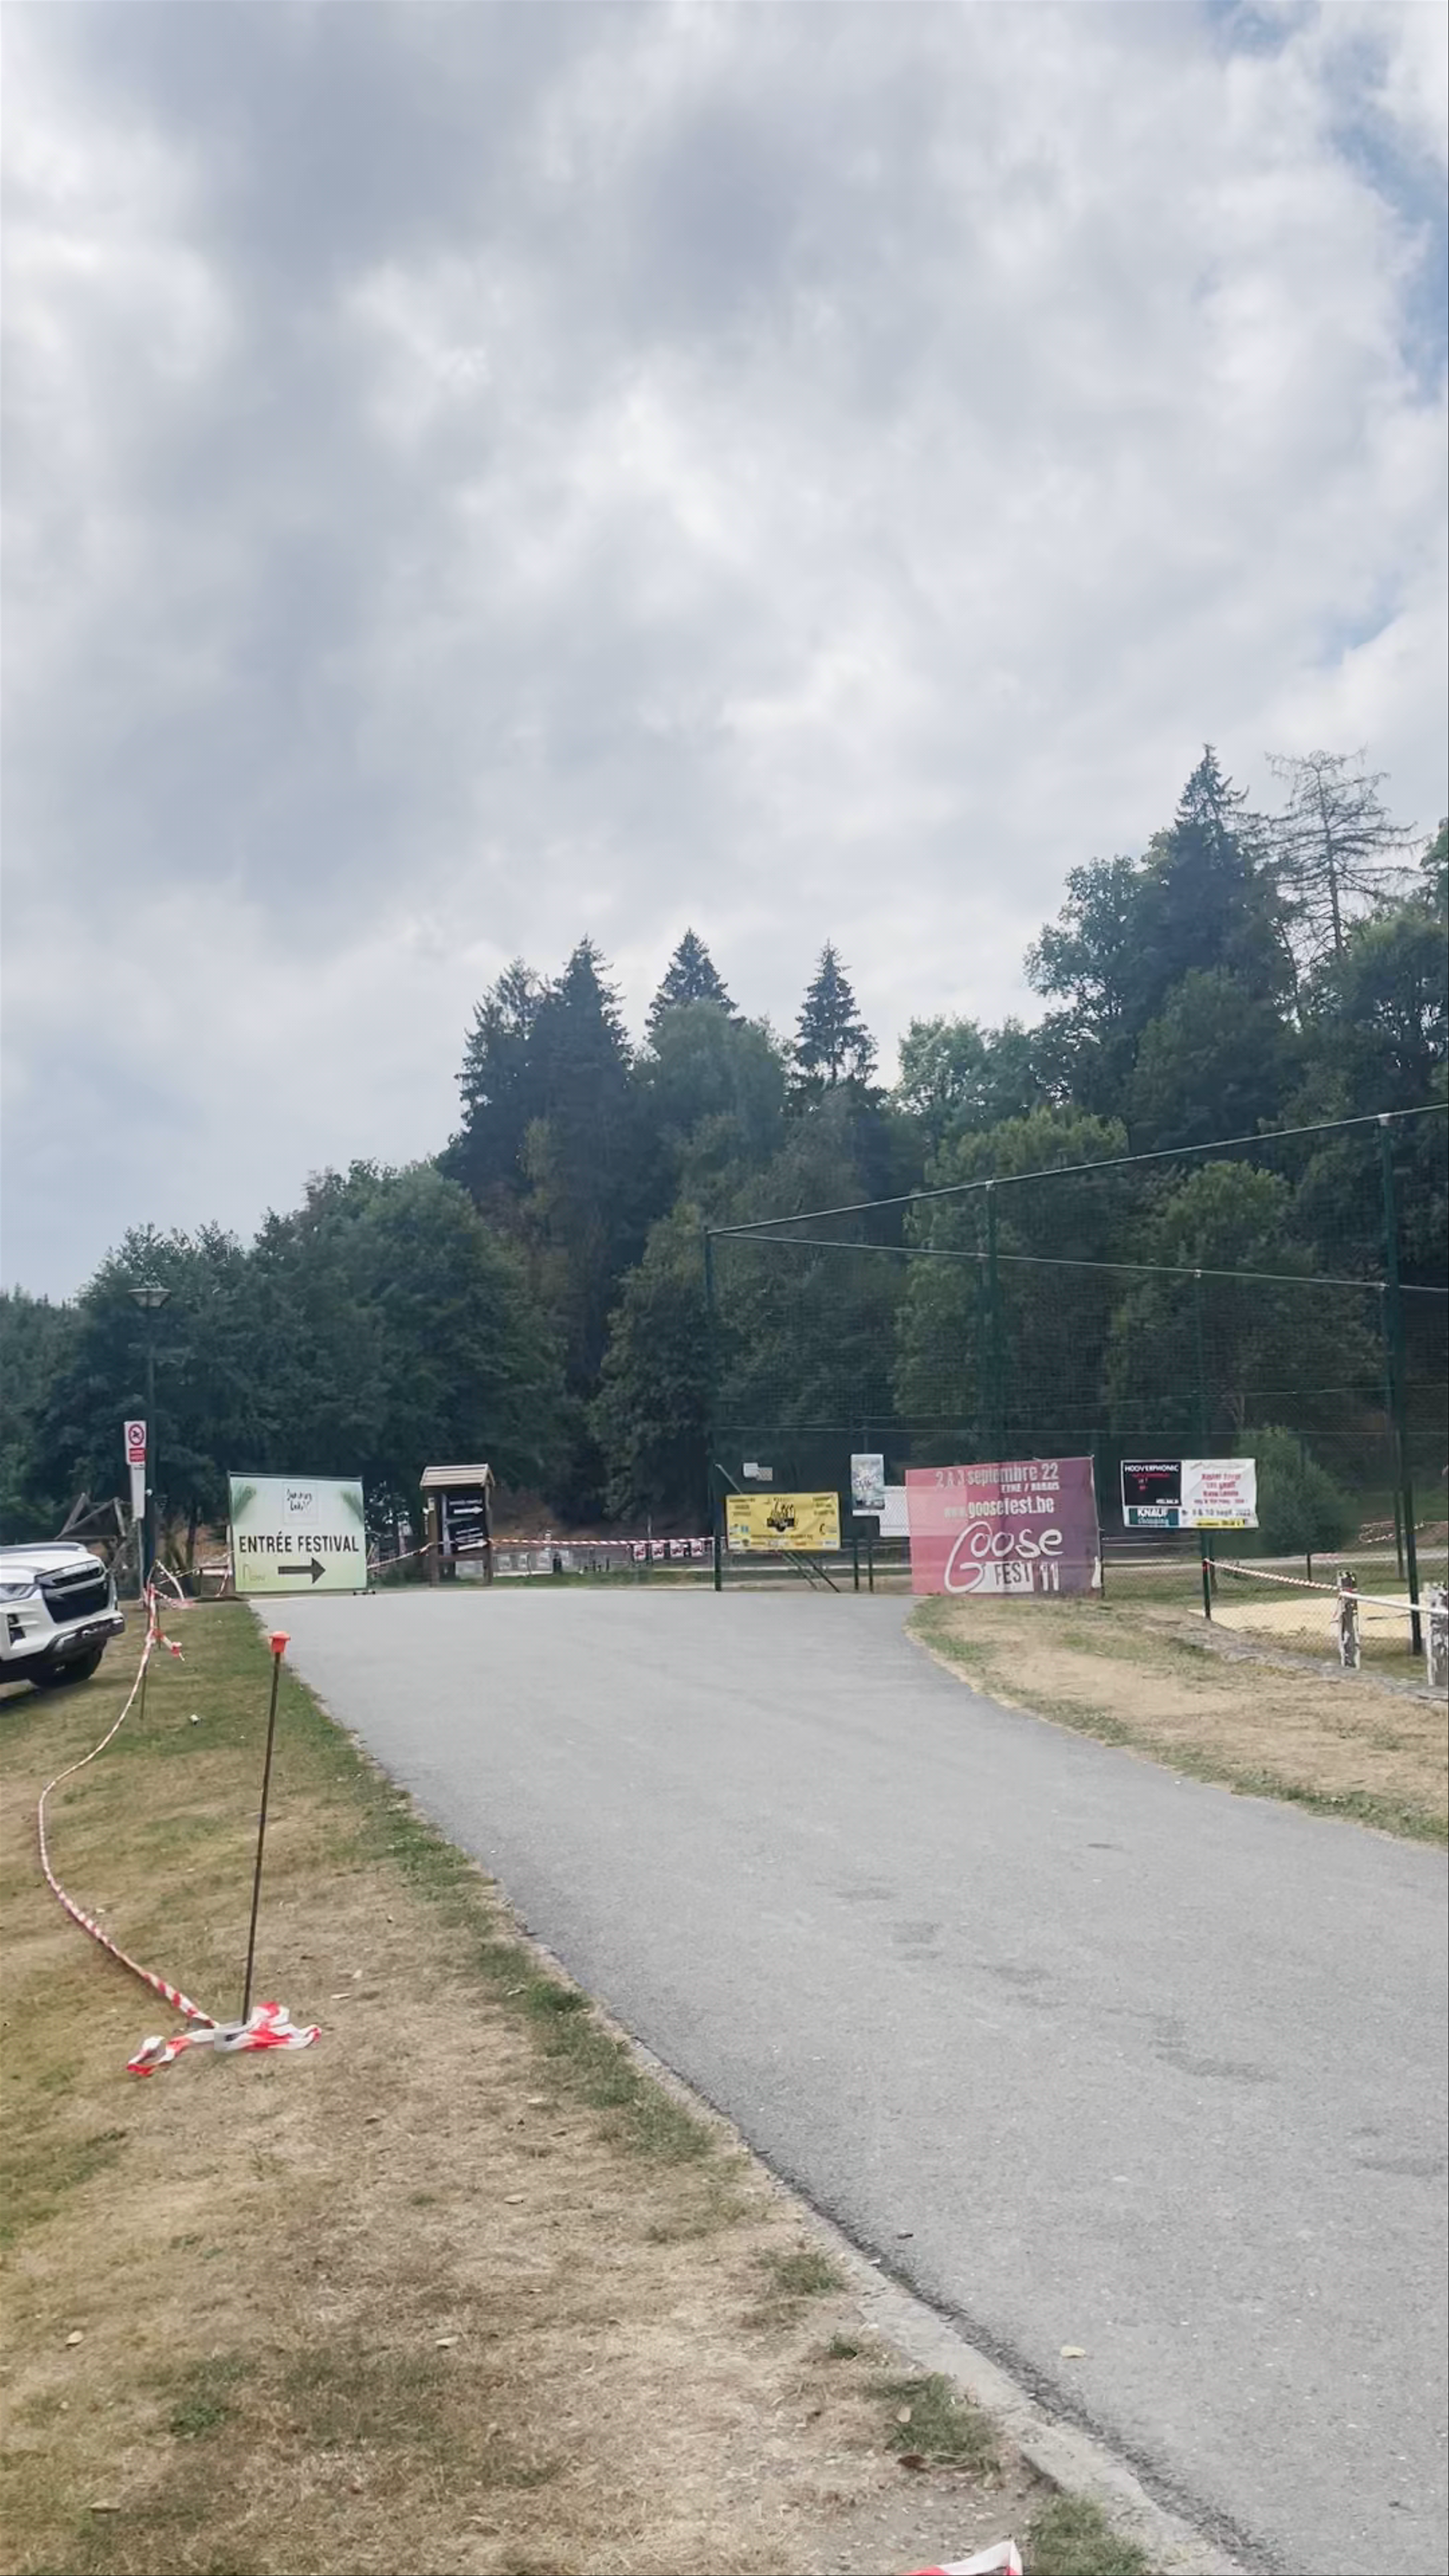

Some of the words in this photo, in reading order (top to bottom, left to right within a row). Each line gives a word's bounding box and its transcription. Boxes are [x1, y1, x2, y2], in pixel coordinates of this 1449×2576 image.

[968, 1464, 1038, 1486] septembre
[1041, 1463, 1059, 1480] 22
[944, 1496, 1054, 1519] www.goosefest.be
[239, 1531, 292, 1553] ENTRÉE
[298, 1535, 359, 1552] FESTIVAL
[944, 1521, 1064, 1593] Goose
[994, 1563, 1031, 1585] FEST
